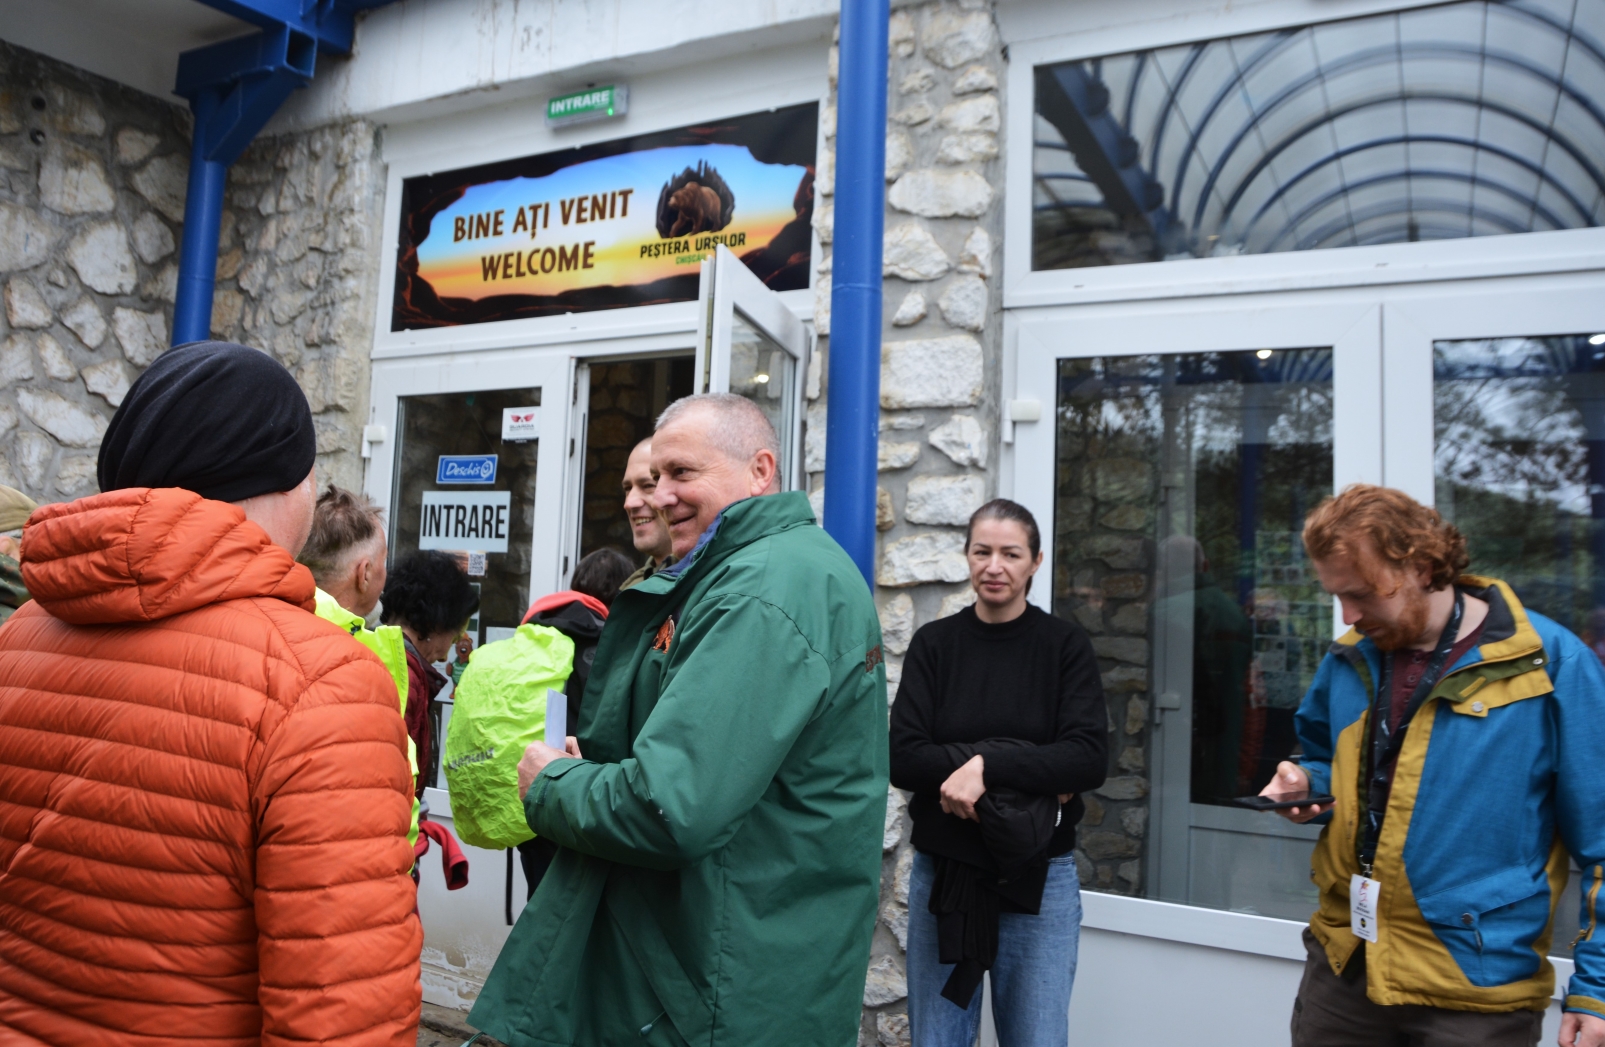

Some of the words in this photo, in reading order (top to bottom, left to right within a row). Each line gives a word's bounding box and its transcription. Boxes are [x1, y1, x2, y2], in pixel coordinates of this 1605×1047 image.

[551, 90, 610, 114] INTRARE
[453, 209, 505, 243] BINE
[511, 202, 550, 240] AȚI
[559, 188, 634, 226] VENIT
[481, 240, 596, 281] WELCOME
[446, 459, 481, 476] Deschis
[422, 504, 507, 539] INTRARE
